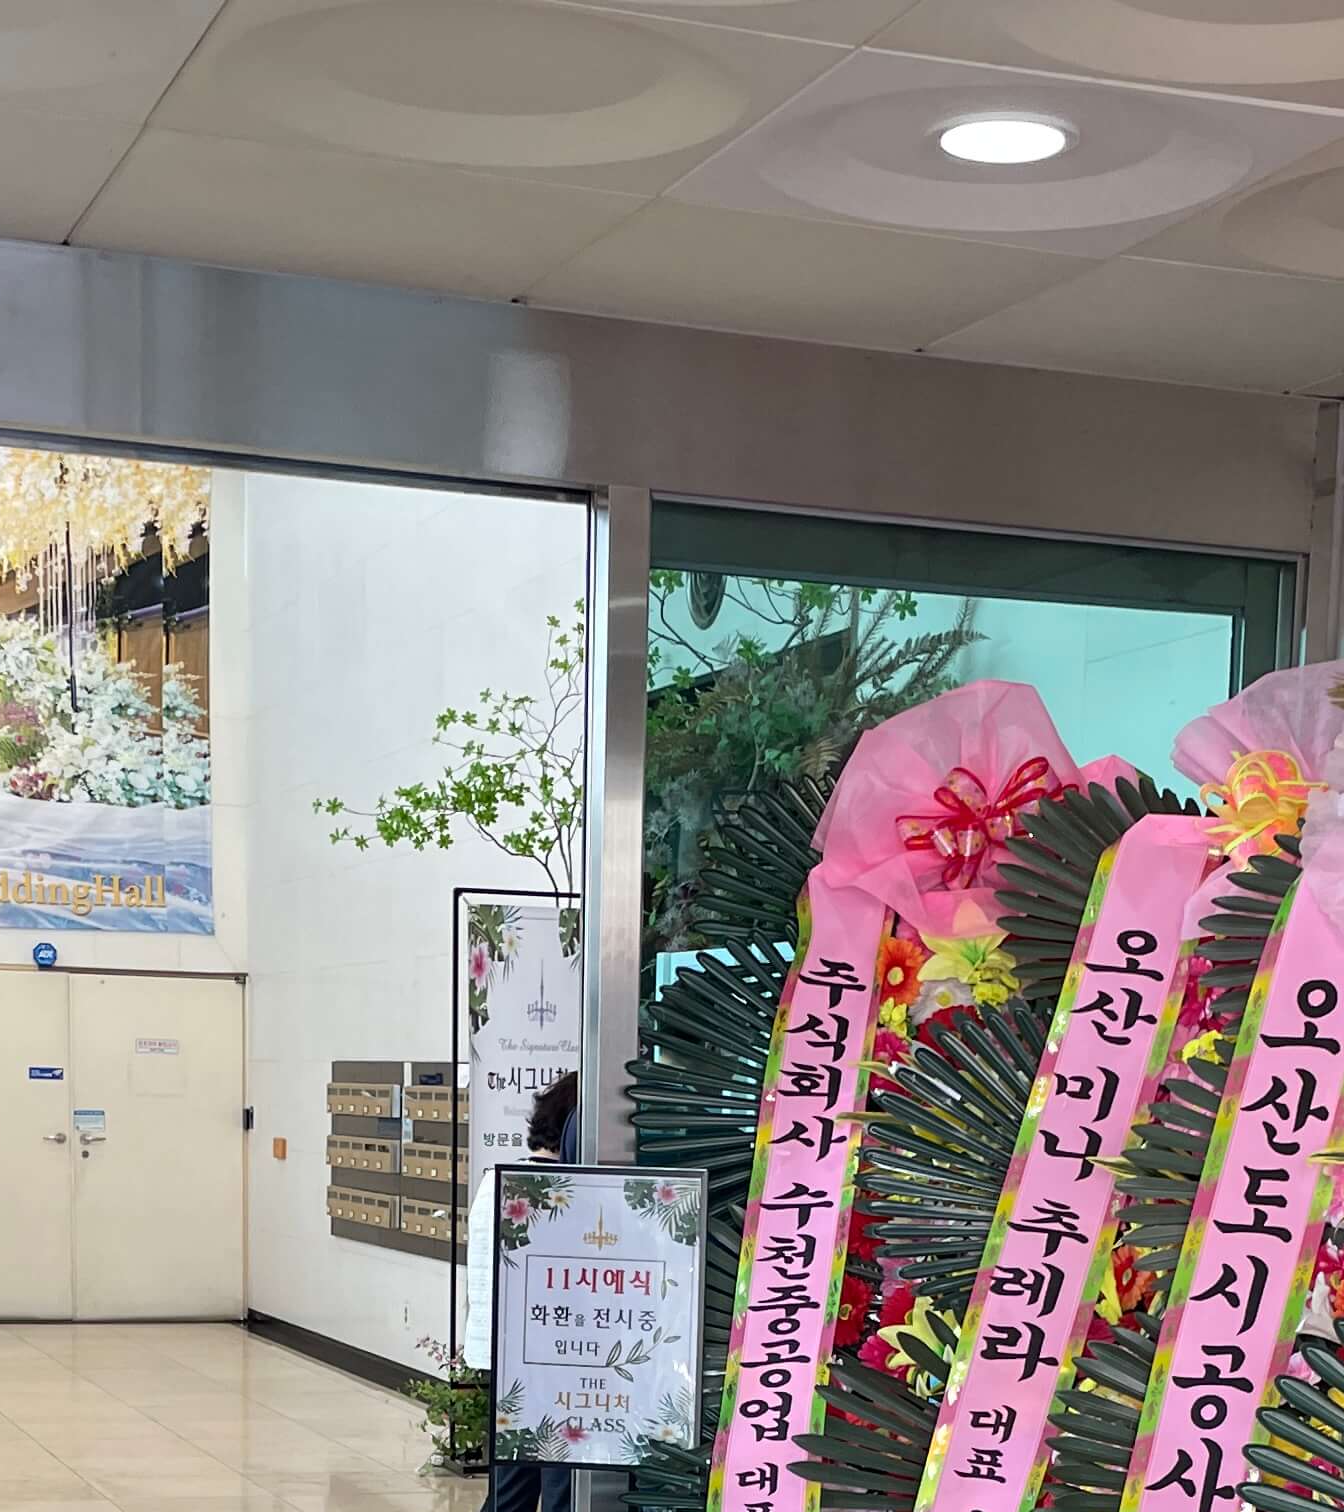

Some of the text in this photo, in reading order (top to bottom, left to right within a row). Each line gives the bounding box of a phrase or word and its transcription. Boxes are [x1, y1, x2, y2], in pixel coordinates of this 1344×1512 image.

[767, 957, 868, 1163] 주식회사
[482, 1131, 523, 1148] 방문을
[980, 1198, 1091, 1382] 추레라
[738, 1181, 835, 1444] 수천중공업
[554, 1339, 601, 1357] 입니다
[579, 1377, 607, 1391] THE
[554, 1390, 631, 1414] 시그니처
[566, 1416, 627, 1433] CLASS
[954, 1404, 1018, 1486] 대표
